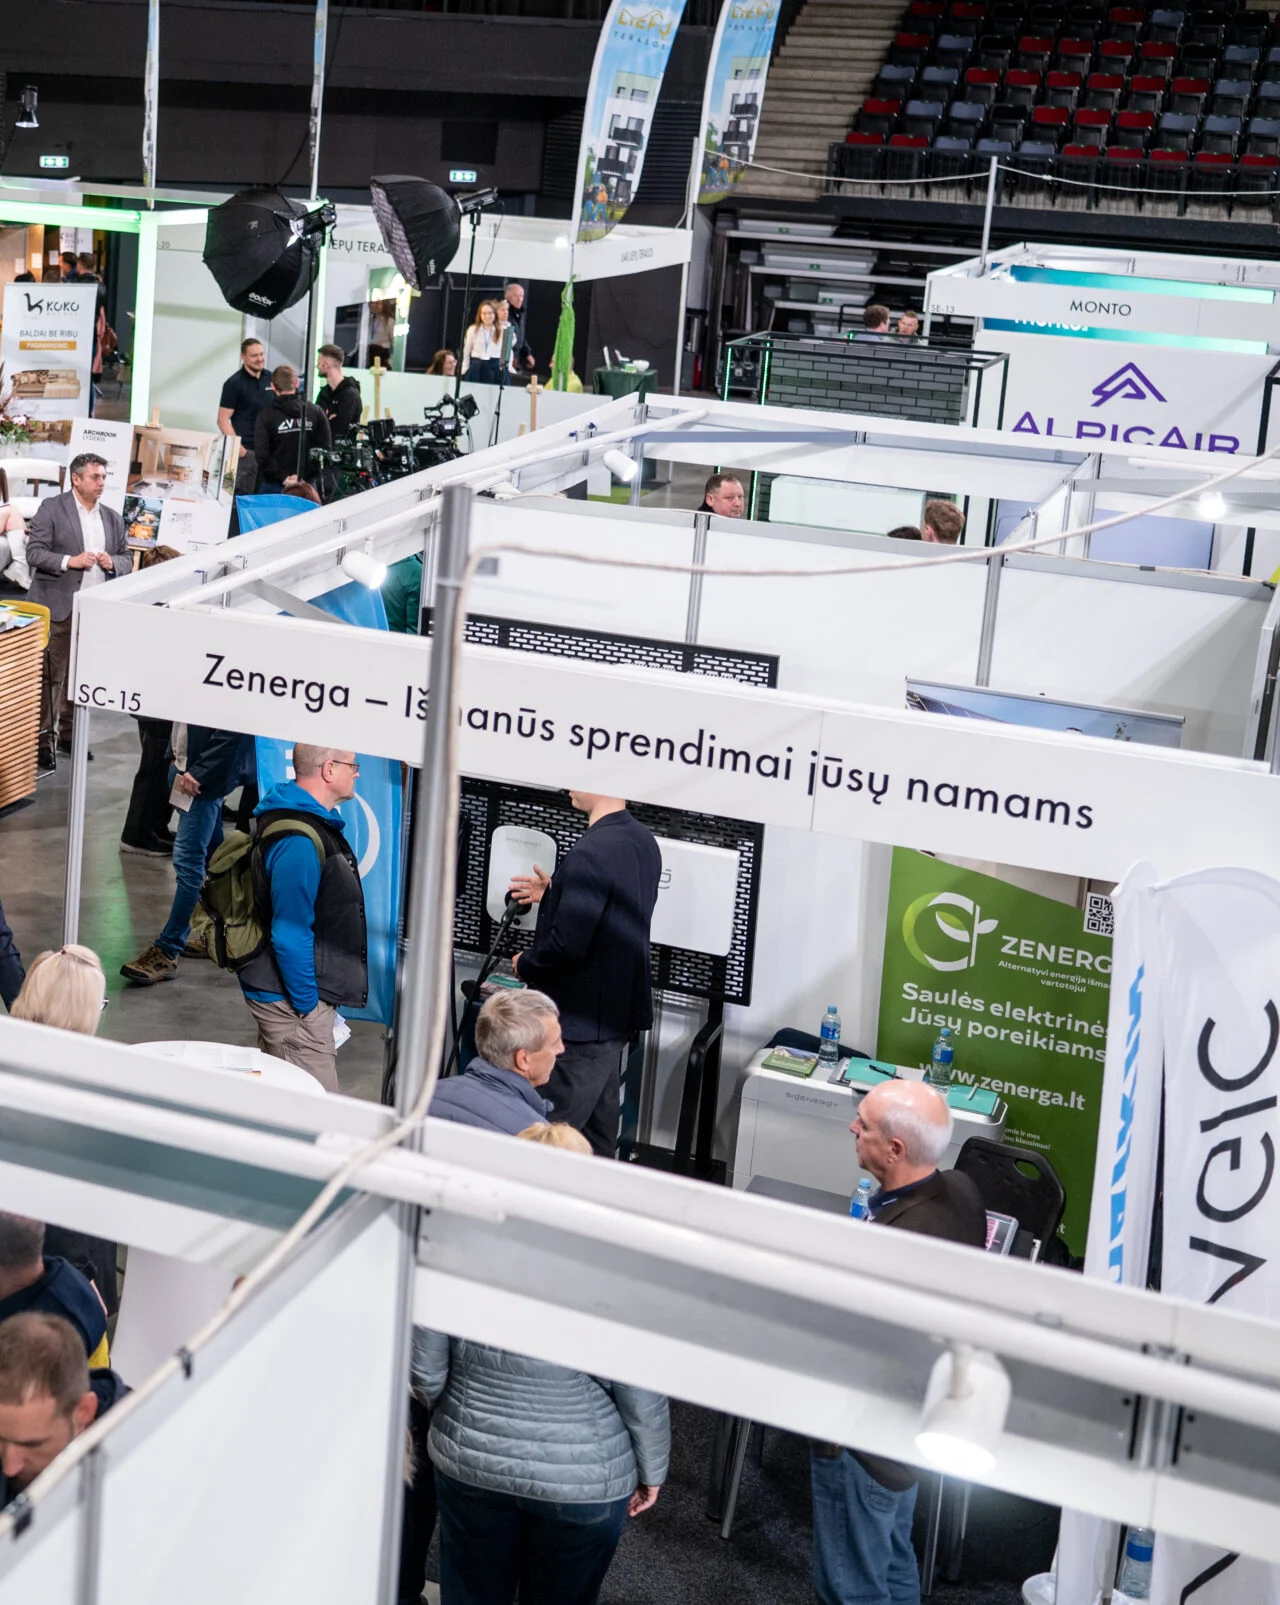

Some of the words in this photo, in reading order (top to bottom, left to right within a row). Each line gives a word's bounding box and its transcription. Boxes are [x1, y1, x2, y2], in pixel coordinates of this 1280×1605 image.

[46, 301, 80, 312] KOKO
[1069, 300, 1132, 317] MONTO
[19, 329, 47, 338] BALDAI
[78, 683, 142, 713] SC-15
[202, 652, 349, 713] Zenerga
[404, 685, 555, 742] Išanūs
[568, 721, 793, 782] sprendimai
[806, 751, 889, 805] jūsų
[906, 771, 1095, 830] namams
[1001, 935, 1113, 974] ZENERG
[998, 960, 1049, 977] Alternatyvi
[1049, 969, 1087, 986] energija
[1087, 976, 1112, 989] išma
[1040, 977, 1087, 993] vartotojui
[902, 981, 985, 1013] Saulės
[901, 1006, 962, 1036] Jūsų
[967, 1020, 1107, 1064] poreikiams
